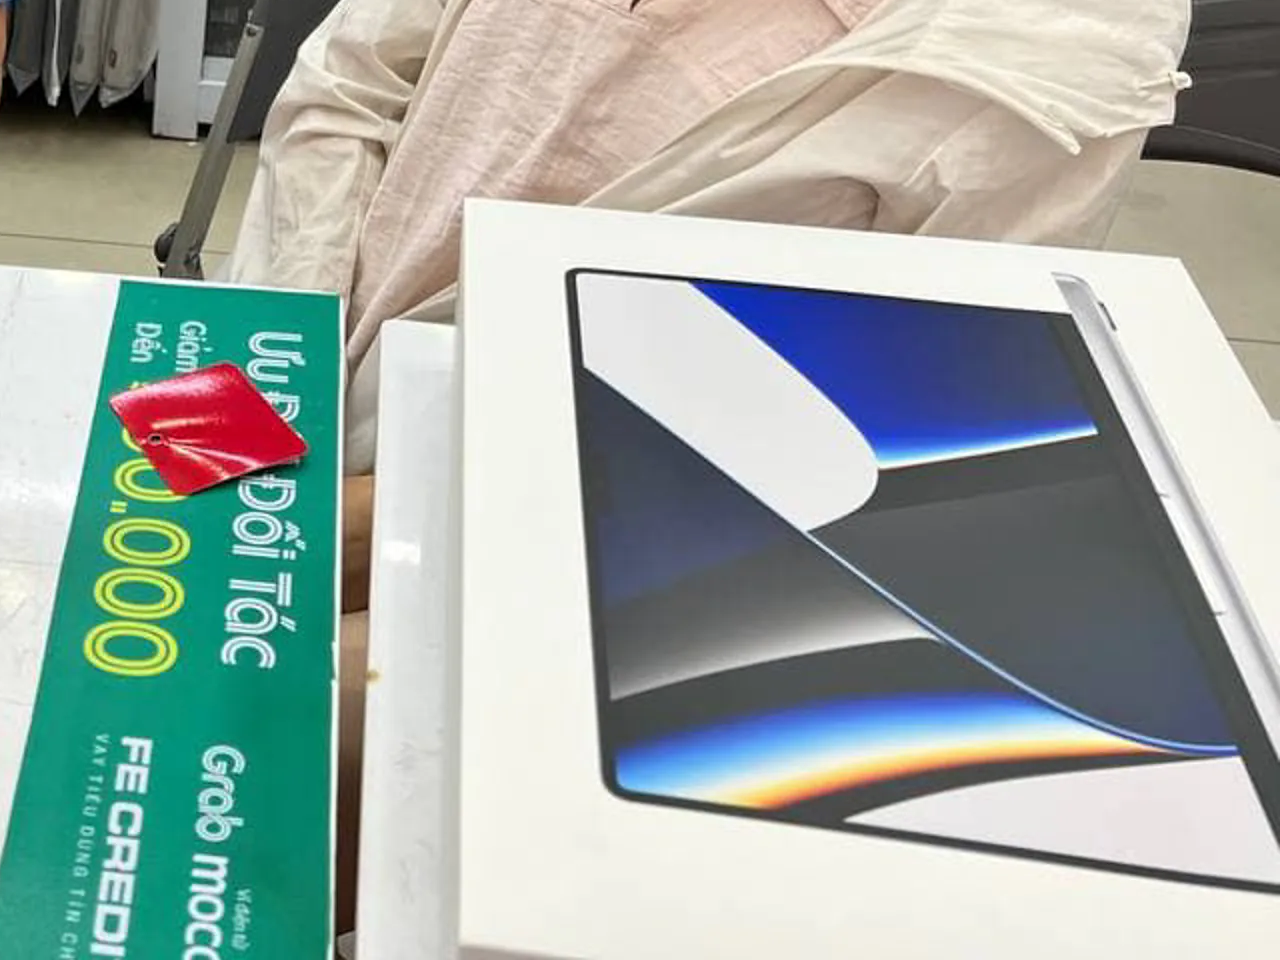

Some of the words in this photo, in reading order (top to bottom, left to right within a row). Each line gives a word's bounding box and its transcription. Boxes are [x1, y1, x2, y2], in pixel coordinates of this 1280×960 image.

[232, 474, 307, 560] Đối
[221, 572, 297, 669] Tác
[93, 734, 111, 766] VAY
[114, 736, 154, 794] FE
[194, 744, 246, 843] Grab
[89, 801, 144, 960] CREDI
